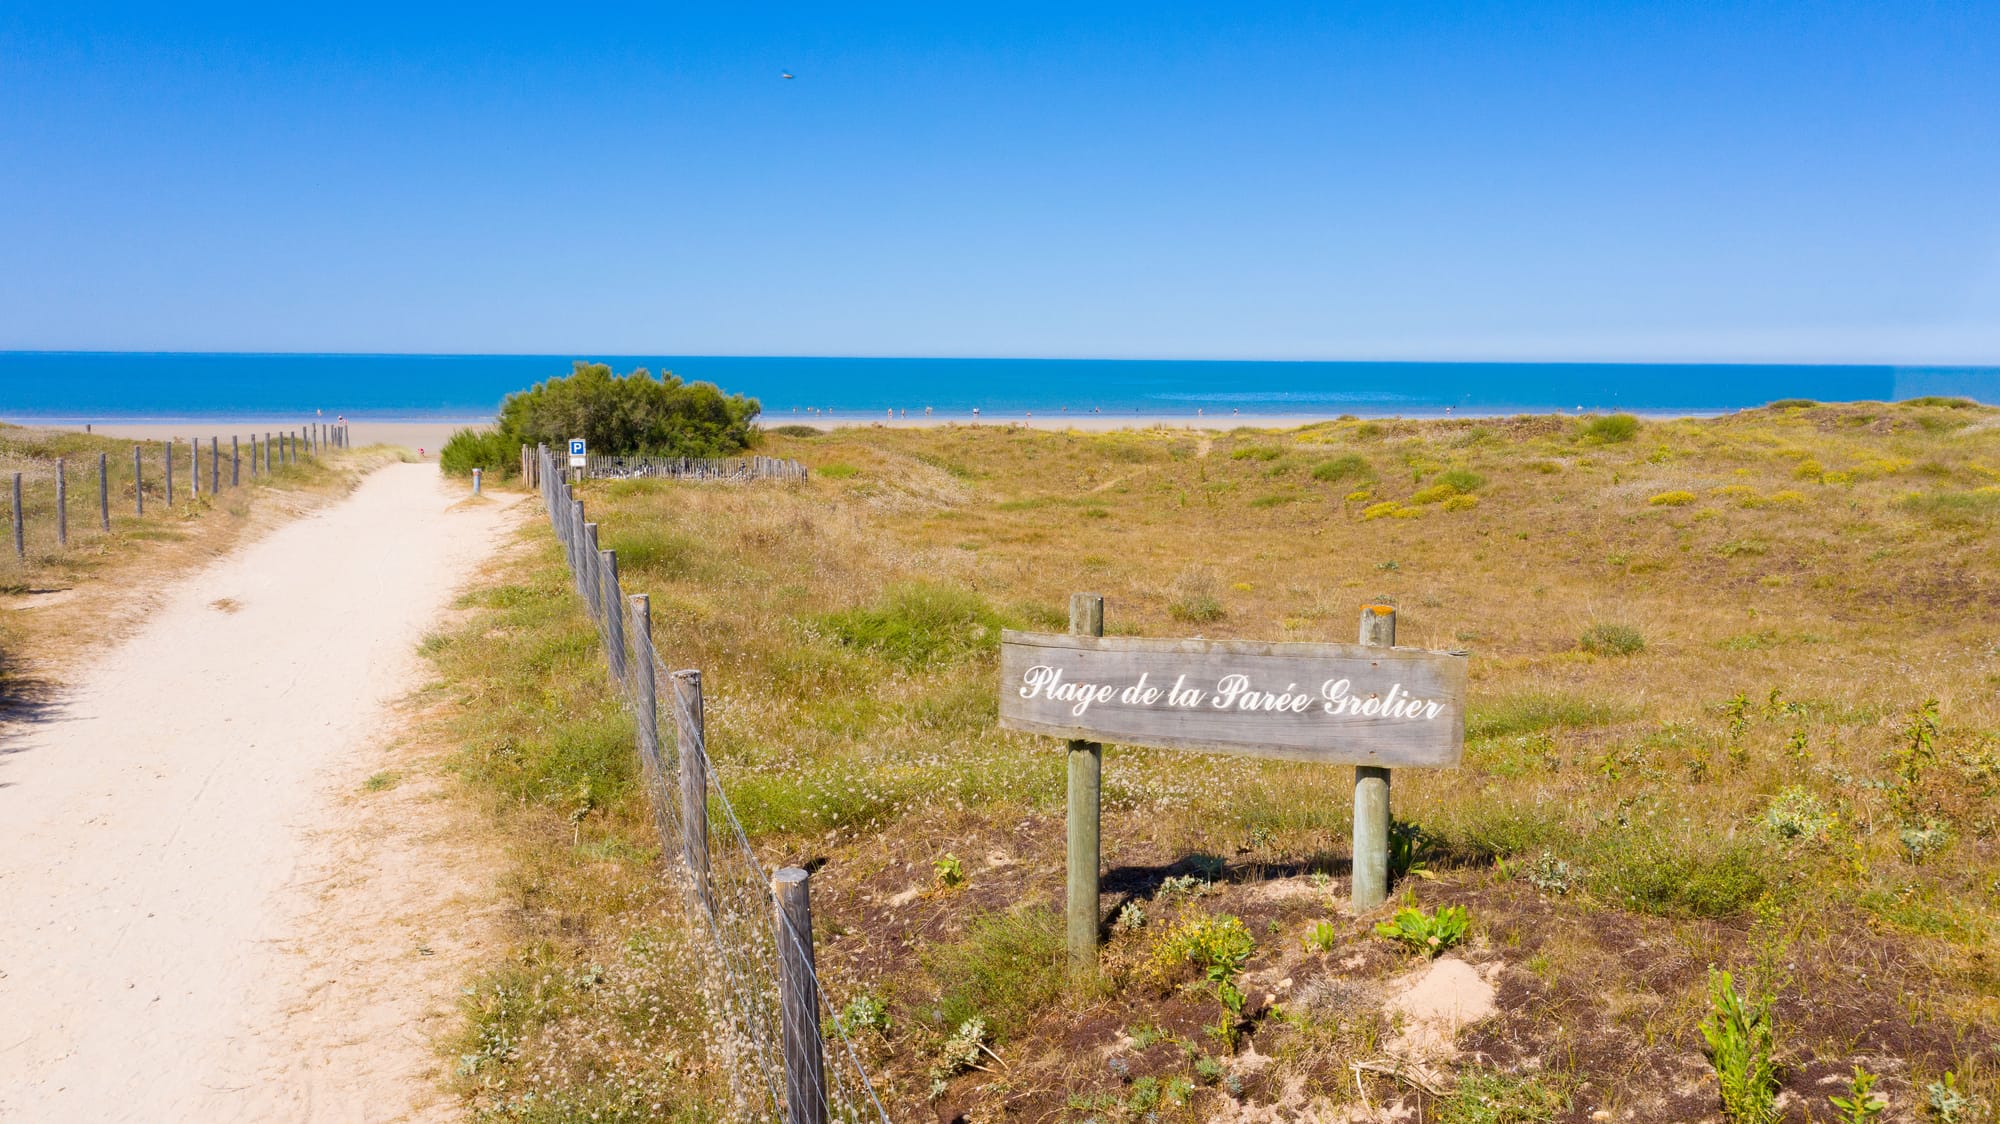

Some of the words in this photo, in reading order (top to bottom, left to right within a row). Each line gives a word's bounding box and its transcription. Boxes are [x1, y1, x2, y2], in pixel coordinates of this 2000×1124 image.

[573, 442, 582, 453] P
[1019, 665, 1119, 717] Plage
[1121, 672, 1165, 705] de
[1168, 673, 1207, 707] la
[1212, 673, 1314, 713] Parée
[1321, 678, 1445, 720] Grolier
